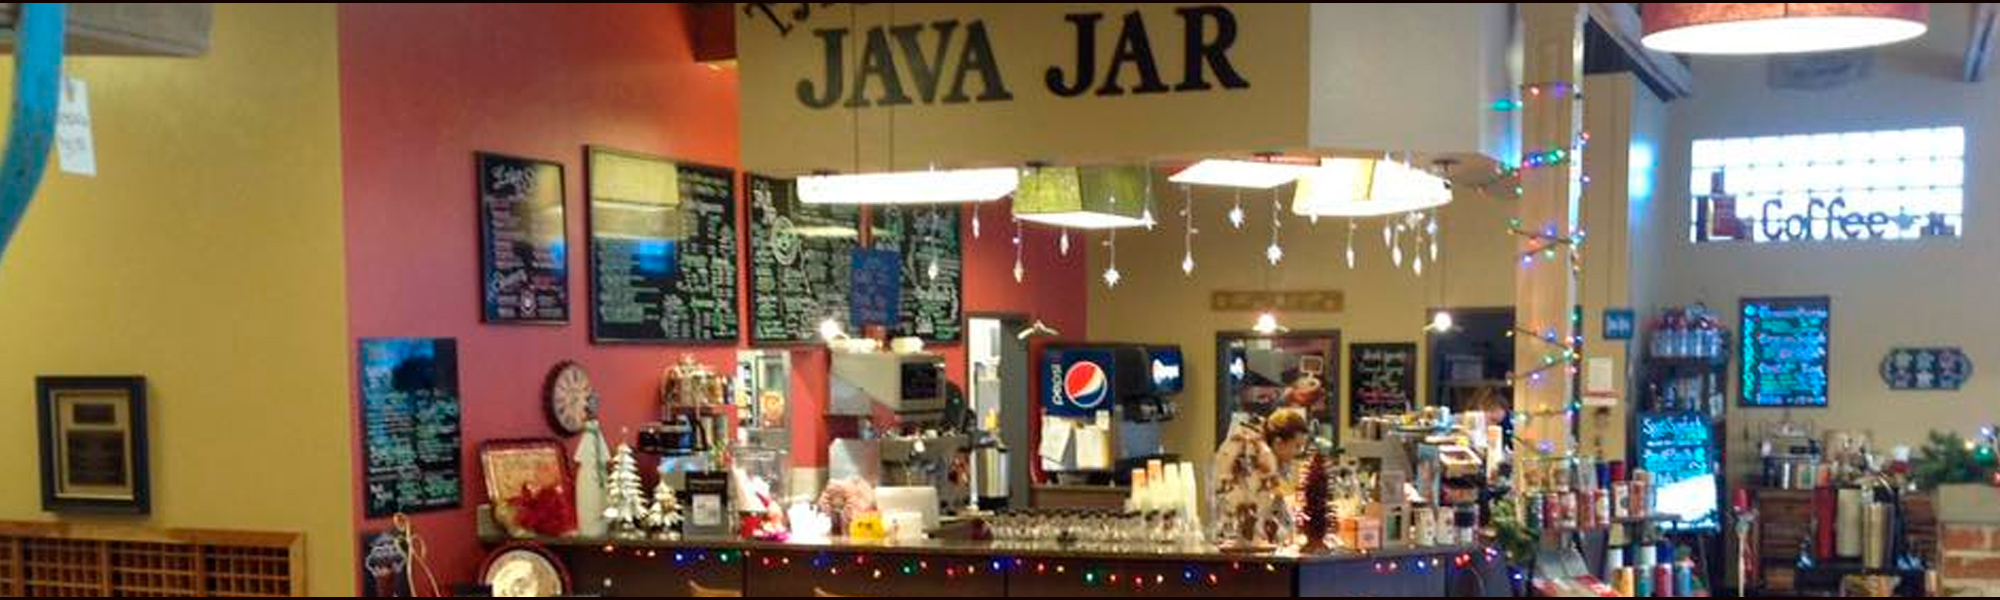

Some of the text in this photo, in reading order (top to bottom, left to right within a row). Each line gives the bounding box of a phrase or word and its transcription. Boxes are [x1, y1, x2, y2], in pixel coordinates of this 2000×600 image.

[796, 5, 1249, 108] JAVA JAR
[1763, 196, 1889, 239] Coffee
